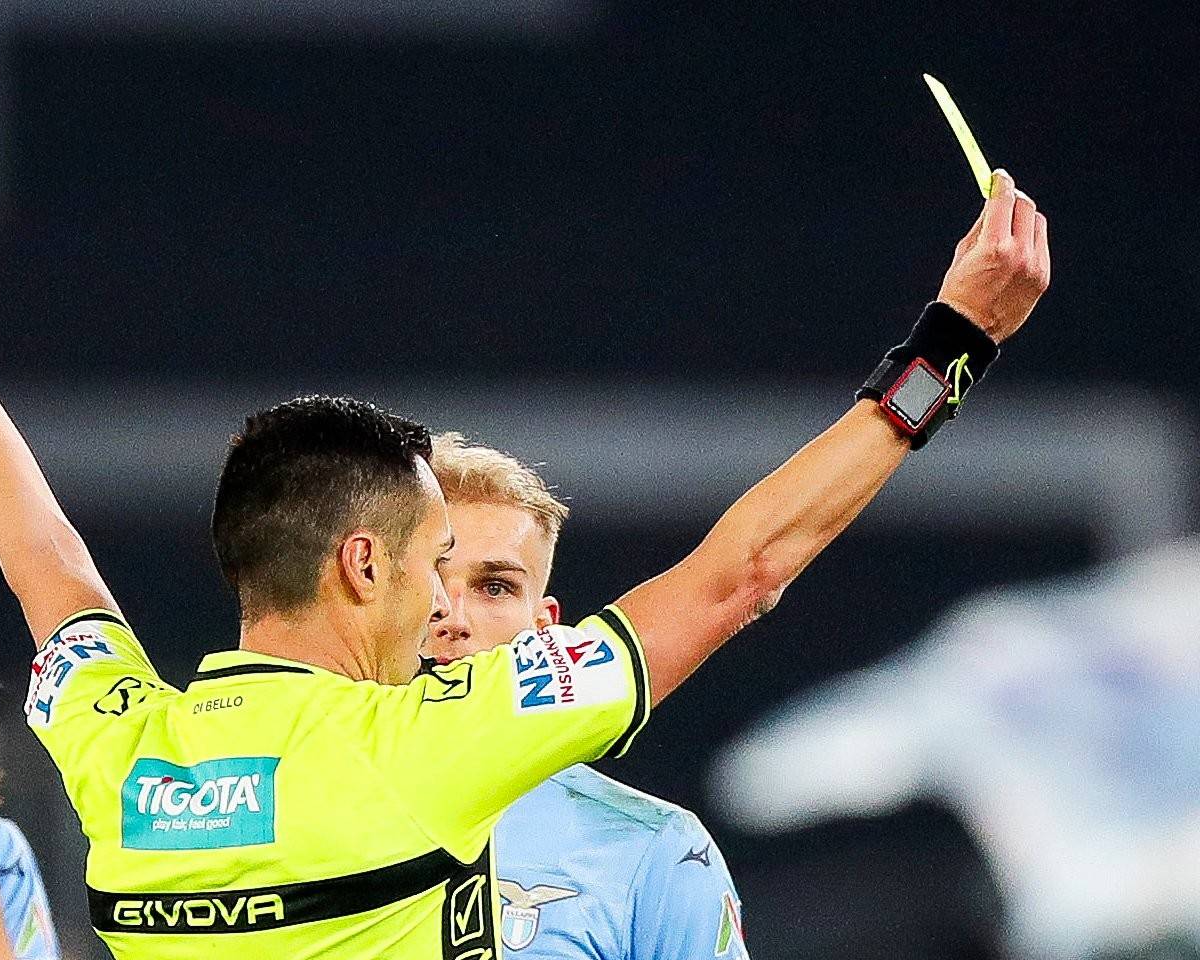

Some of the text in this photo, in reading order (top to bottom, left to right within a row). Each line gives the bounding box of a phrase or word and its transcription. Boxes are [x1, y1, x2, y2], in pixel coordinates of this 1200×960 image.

[205, 696, 243, 712] BELLO
[206, 816, 231, 831] good
[113, 894, 285, 927] GIVOVA
